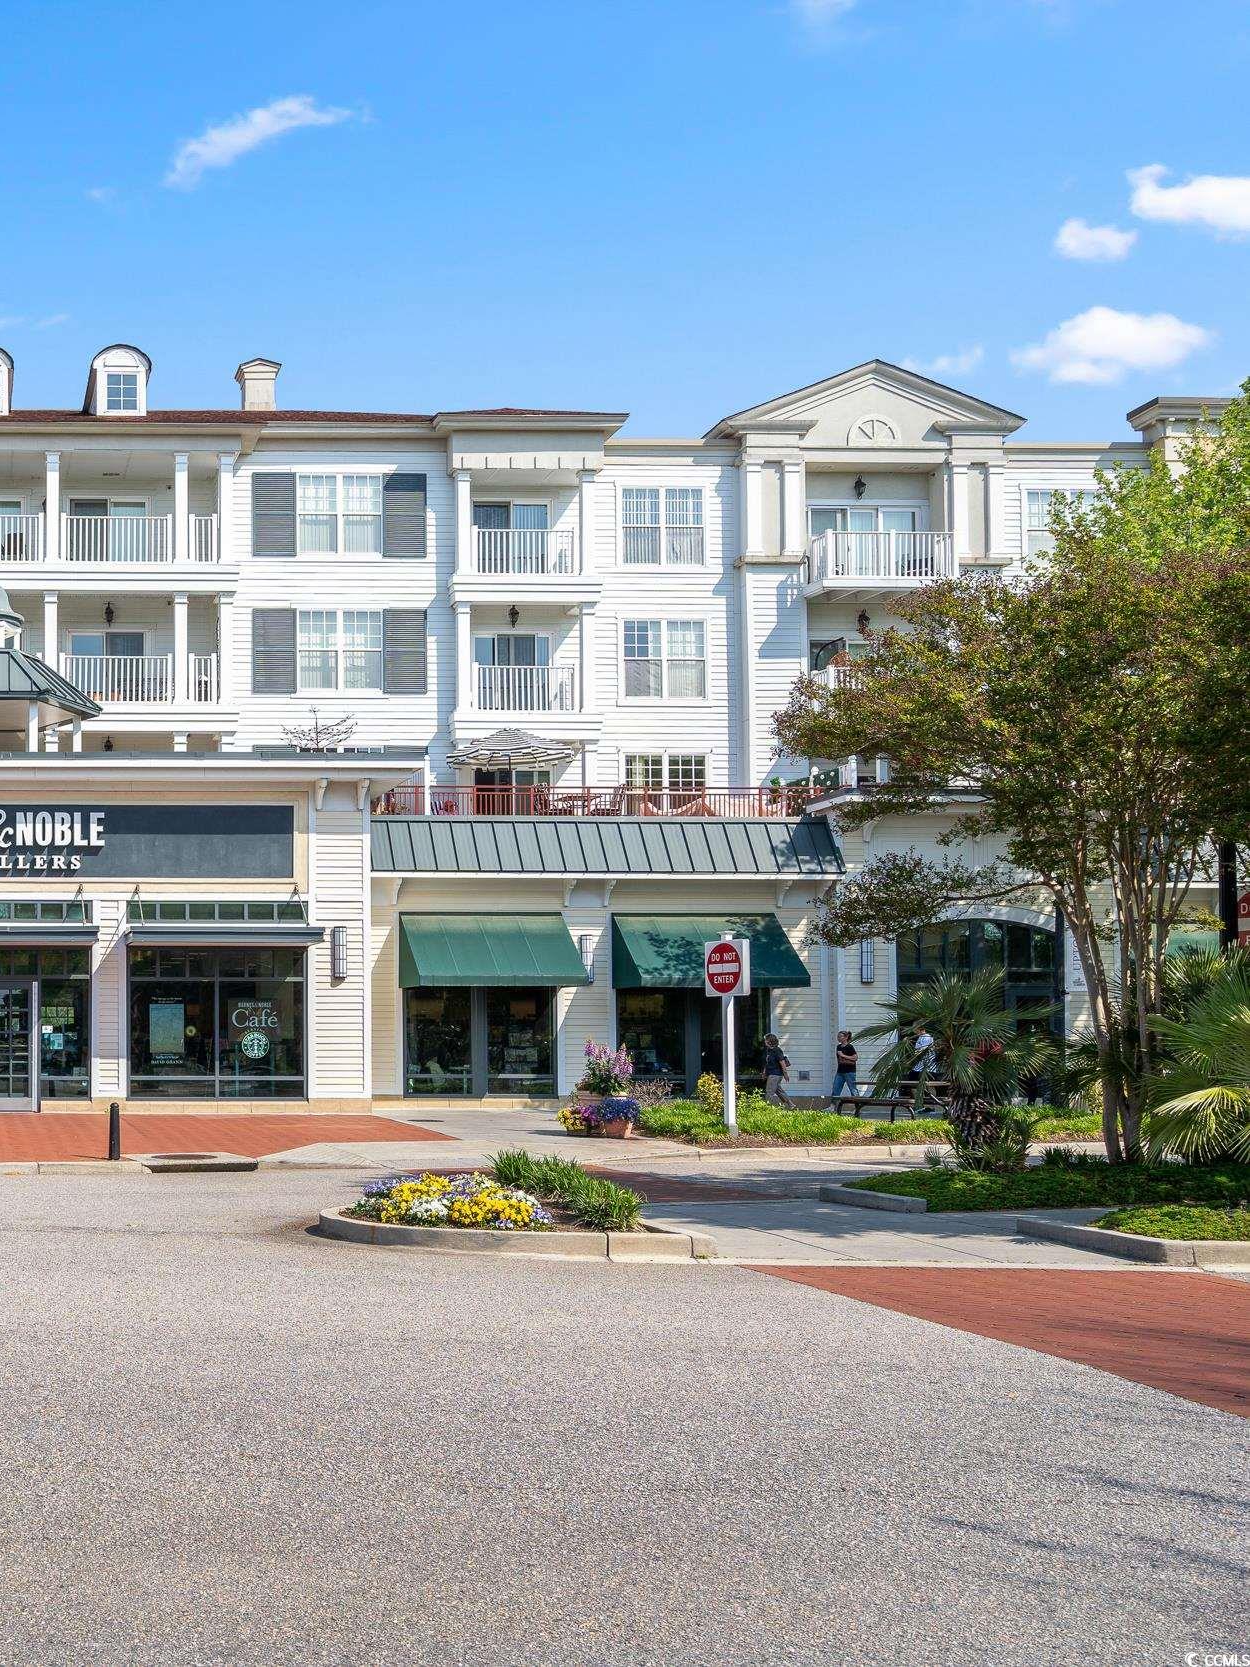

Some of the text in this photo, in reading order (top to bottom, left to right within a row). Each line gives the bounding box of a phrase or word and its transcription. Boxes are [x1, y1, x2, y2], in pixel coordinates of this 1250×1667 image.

[711, 952, 736, 961] DO NOT
[713, 975, 734, 983] ENTER
[232, 1009, 278, 1027] Café
